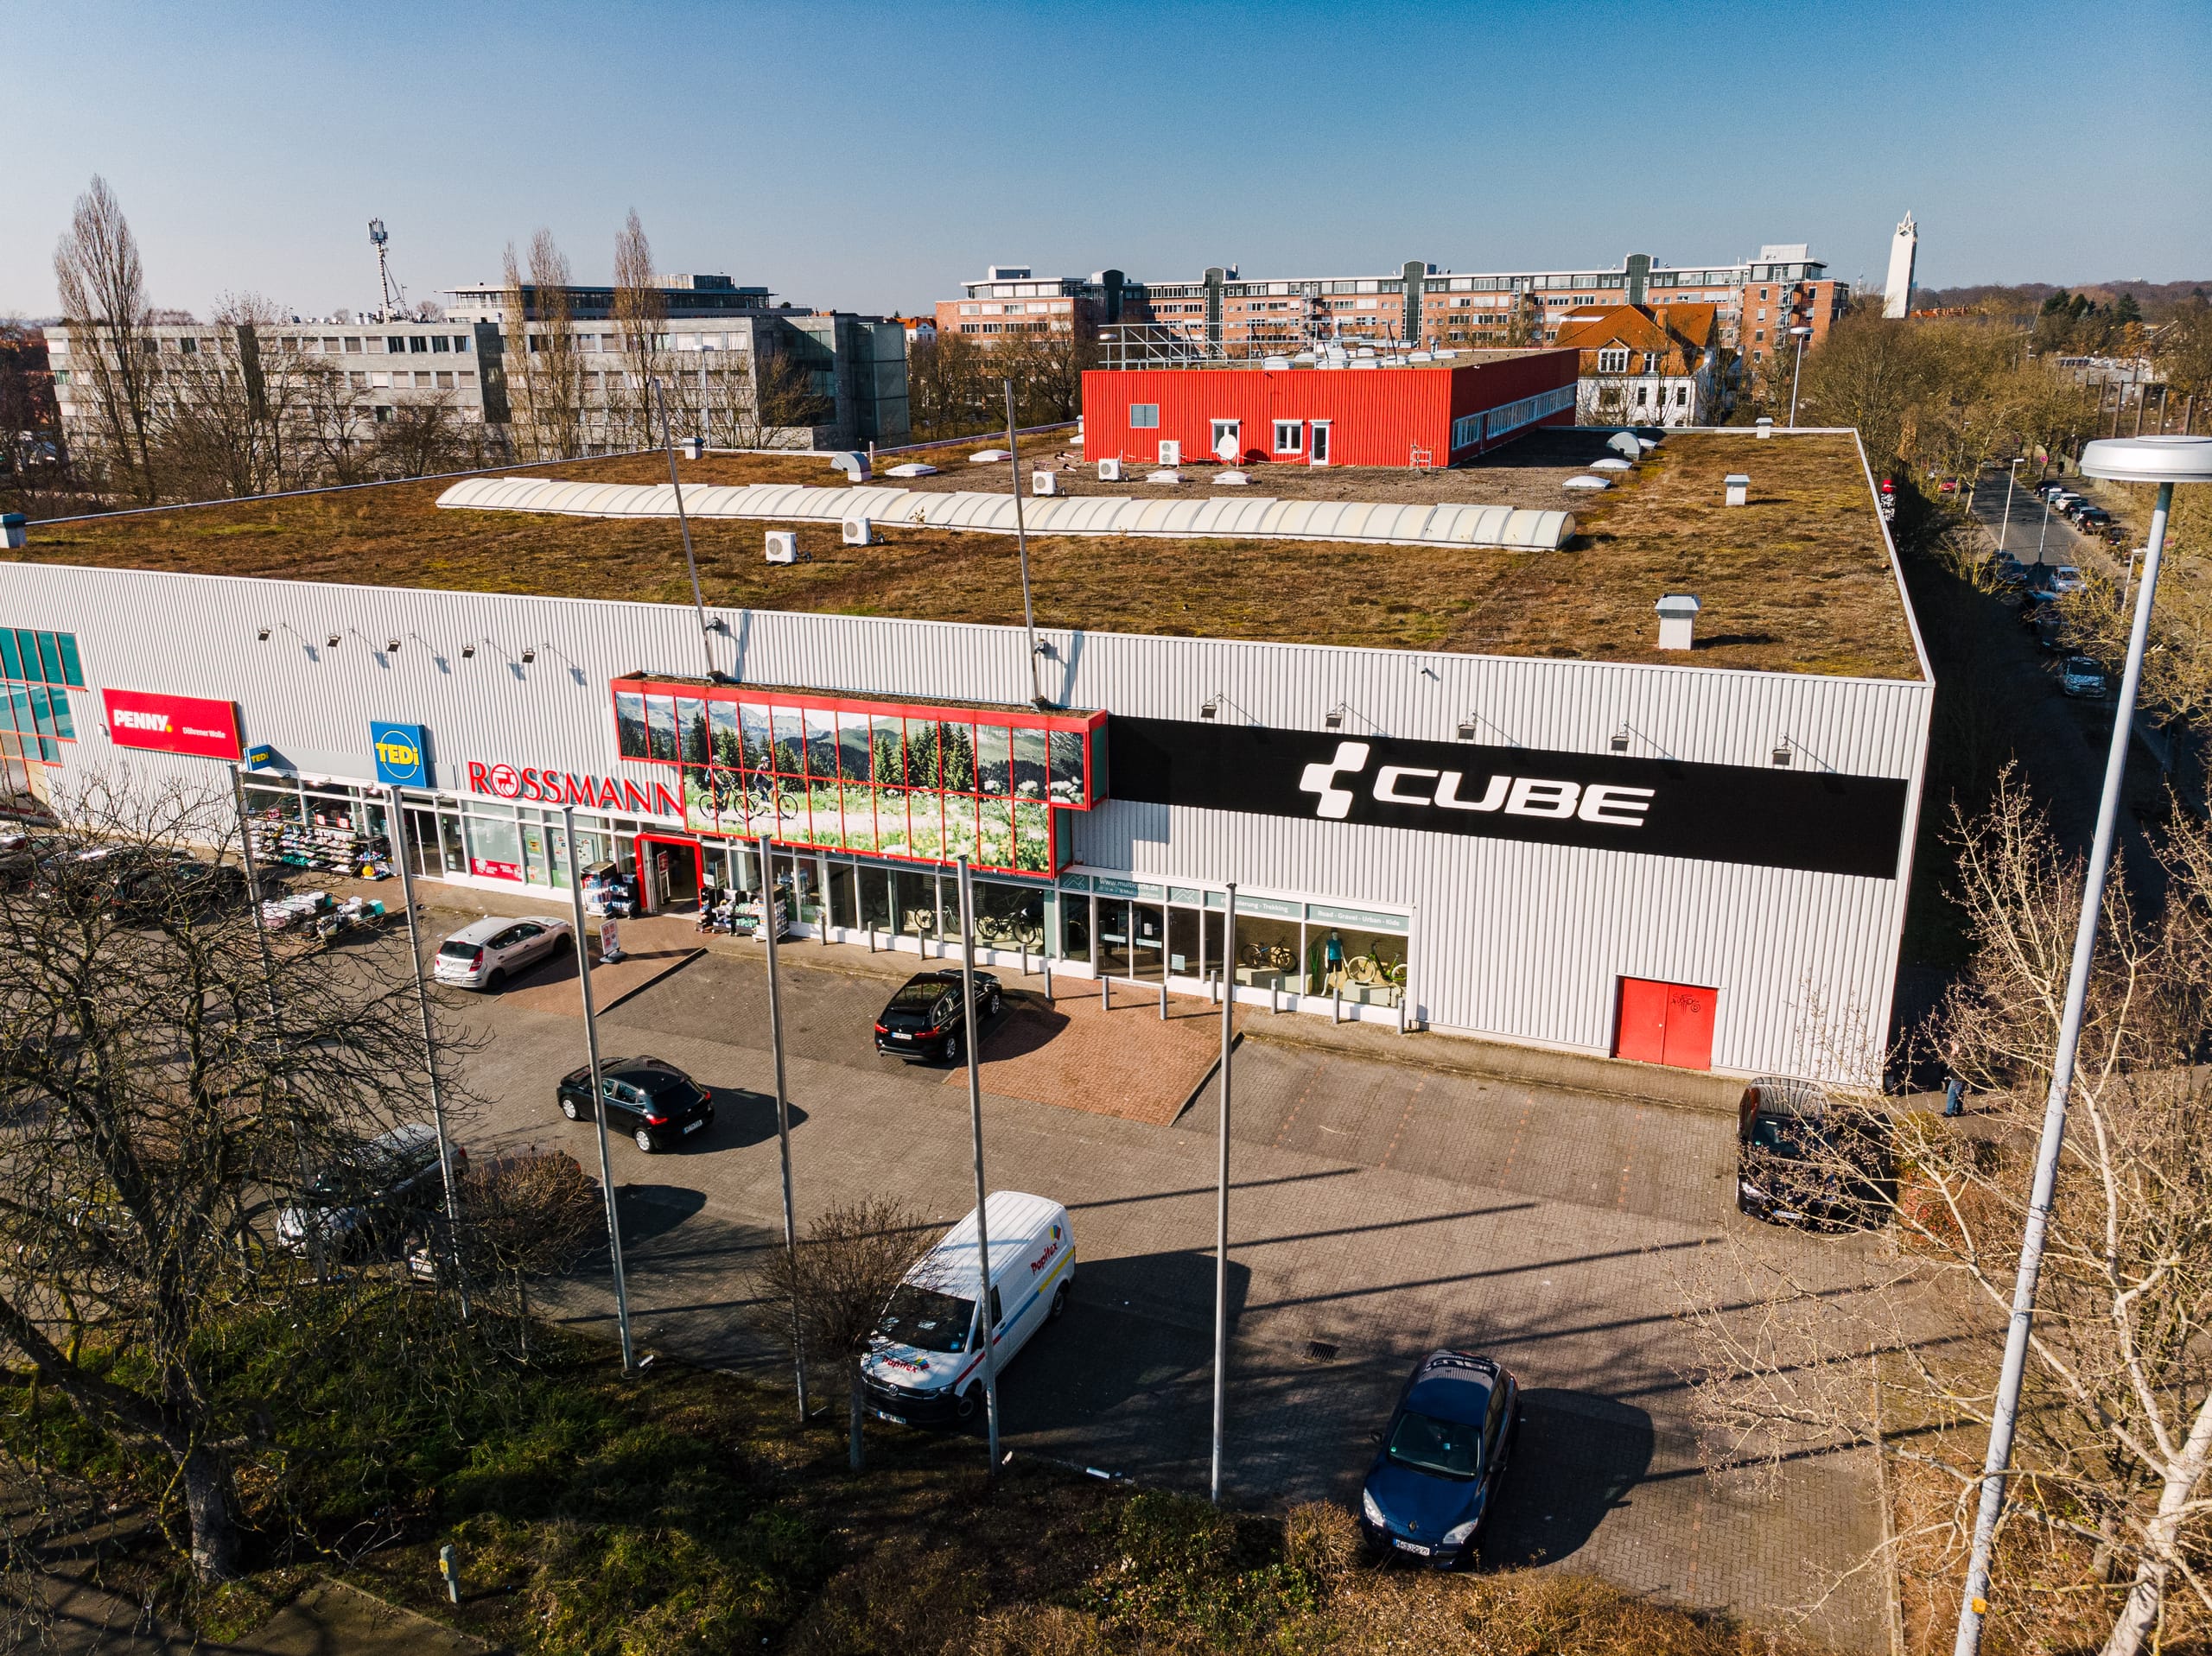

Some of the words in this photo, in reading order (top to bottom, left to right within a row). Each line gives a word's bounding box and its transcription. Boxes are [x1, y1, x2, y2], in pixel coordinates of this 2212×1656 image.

[467, 760, 684, 816] ROSSMANN
[1372, 765, 1656, 827] CUBE
[1262, 903, 1288, 913] Trekking
[1338, 912, 1357, 921] Gravel
[1362, 915, 1382, 923] Urban
